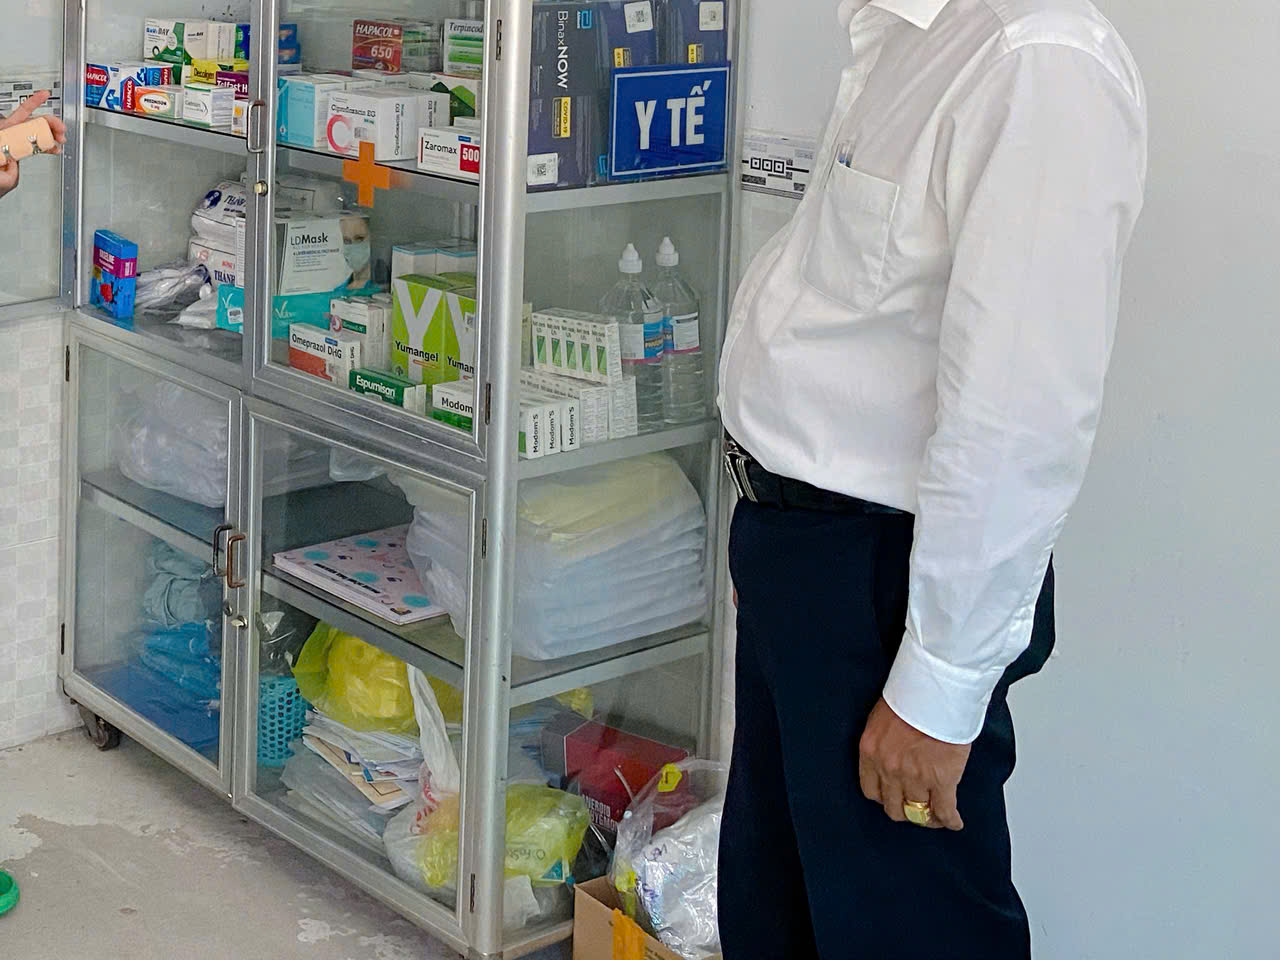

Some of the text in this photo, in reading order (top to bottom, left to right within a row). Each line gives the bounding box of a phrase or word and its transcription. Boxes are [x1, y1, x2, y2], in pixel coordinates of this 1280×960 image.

[355, 23, 393, 37] HAPACOL
[370, 45, 393, 59] 650
[557, 10, 569, 89] BinaxNOW
[634, 79, 712, 150] Y TẾ
[424, 140, 458, 155] Zaromax
[291, 333, 326, 354] Omeprazol
[395, 340, 439, 363] Yumangel
[356, 375, 396, 397] Espumisan
